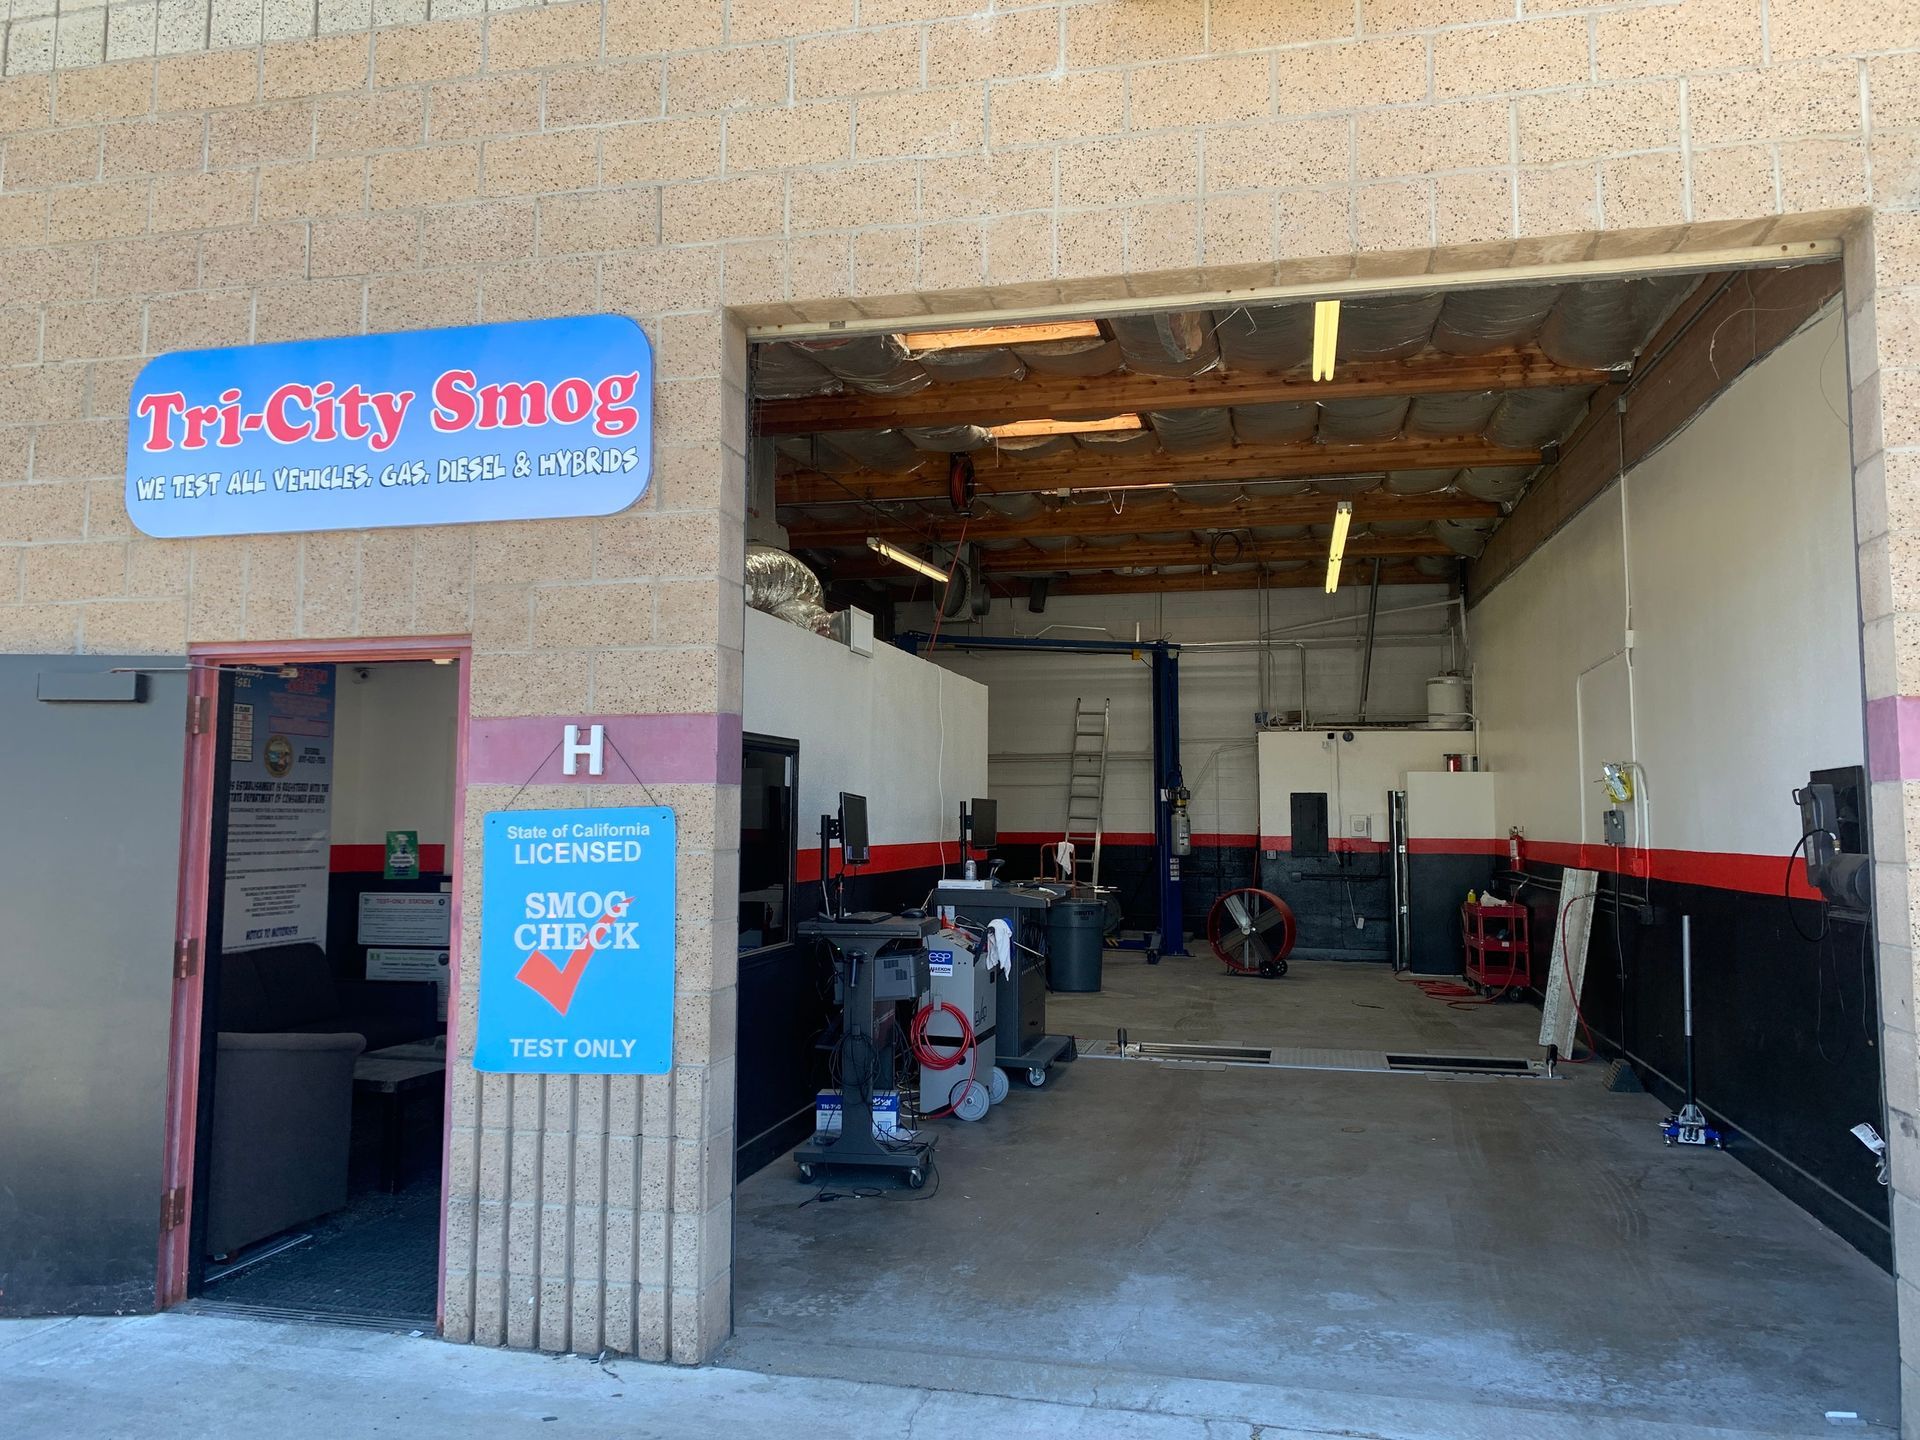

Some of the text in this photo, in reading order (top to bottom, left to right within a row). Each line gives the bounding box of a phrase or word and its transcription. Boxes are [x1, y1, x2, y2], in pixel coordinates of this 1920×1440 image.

[137, 369, 640, 453] Tri-City Smog
[136, 476, 164, 502] WE
[171, 472, 221, 499] TEST
[226, 467, 267, 495] ALL
[437, 454, 506, 484] DIESEL
[512, 453, 531, 478] &
[538, 445, 640, 477] HYBRIDS
[563, 724, 605, 776] H
[506, 822, 650, 841] State of California
[514, 841, 642, 865] LICENSED
[525, 890, 630, 920] SMOG
[513, 921, 640, 951] CHECK
[509, 1038, 637, 1058] TEST ONLY
